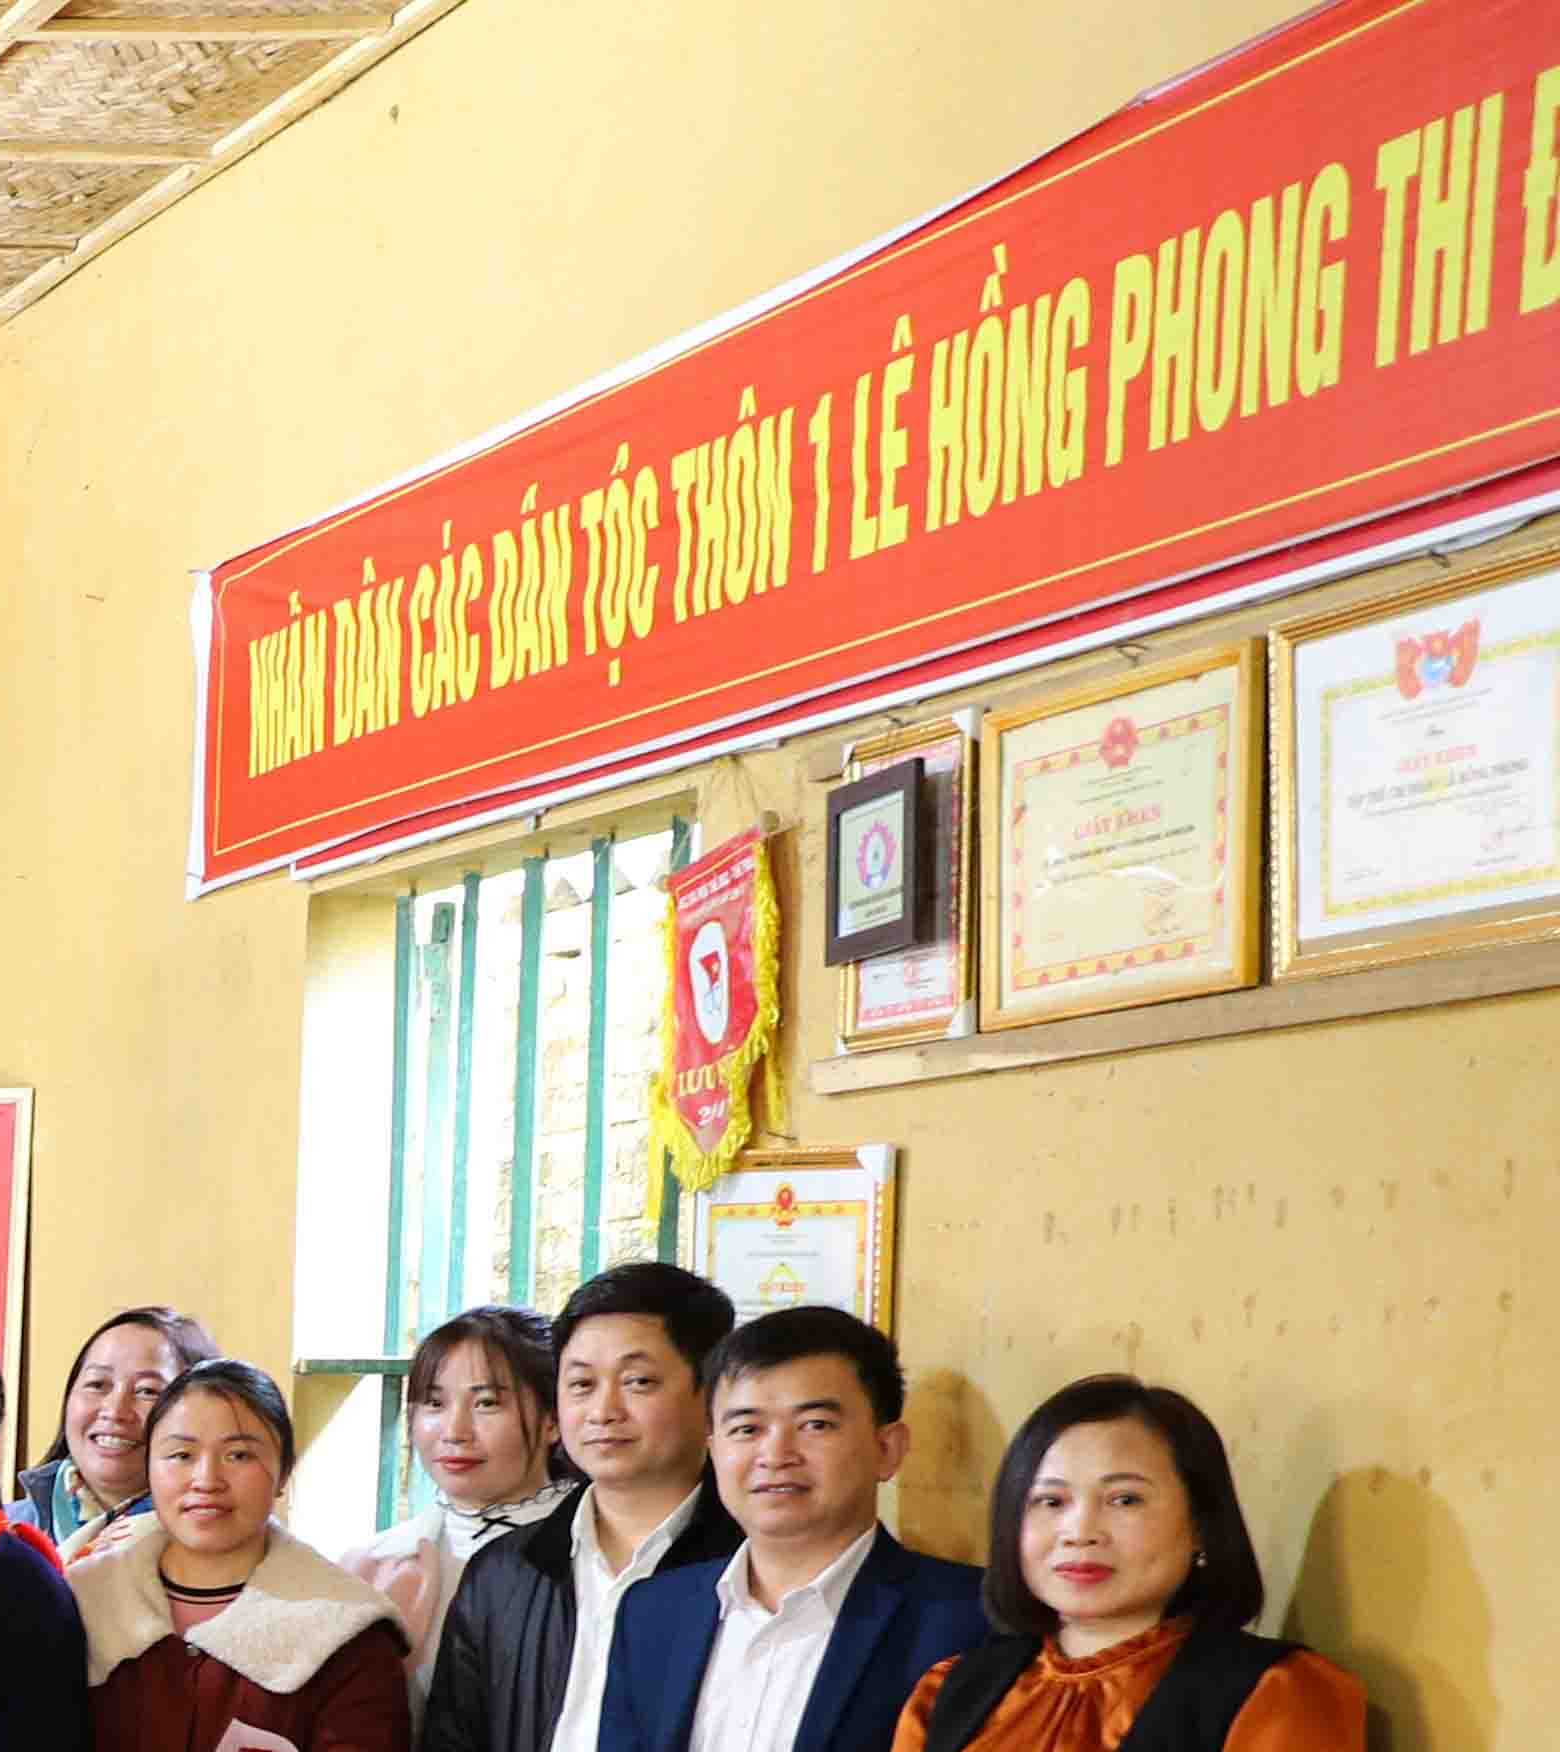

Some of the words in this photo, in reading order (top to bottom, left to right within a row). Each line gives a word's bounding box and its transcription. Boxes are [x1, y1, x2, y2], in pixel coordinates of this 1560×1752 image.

[249, 591, 326, 778] NHÂN
[334, 557, 403, 748] DÂN
[409, 520, 481, 720] CÁC
[489, 484, 572, 689] DÂN
[582, 442, 659, 686] TỘC
[672, 385, 795, 624] THÔN
[809, 392, 831, 574] 1
[849, 314, 914, 561] LÊ
[925, 243, 1090, 532] HỒNG
[1104, 162, 1349, 467] PHONG
[1375, 91, 1503, 368] THI
